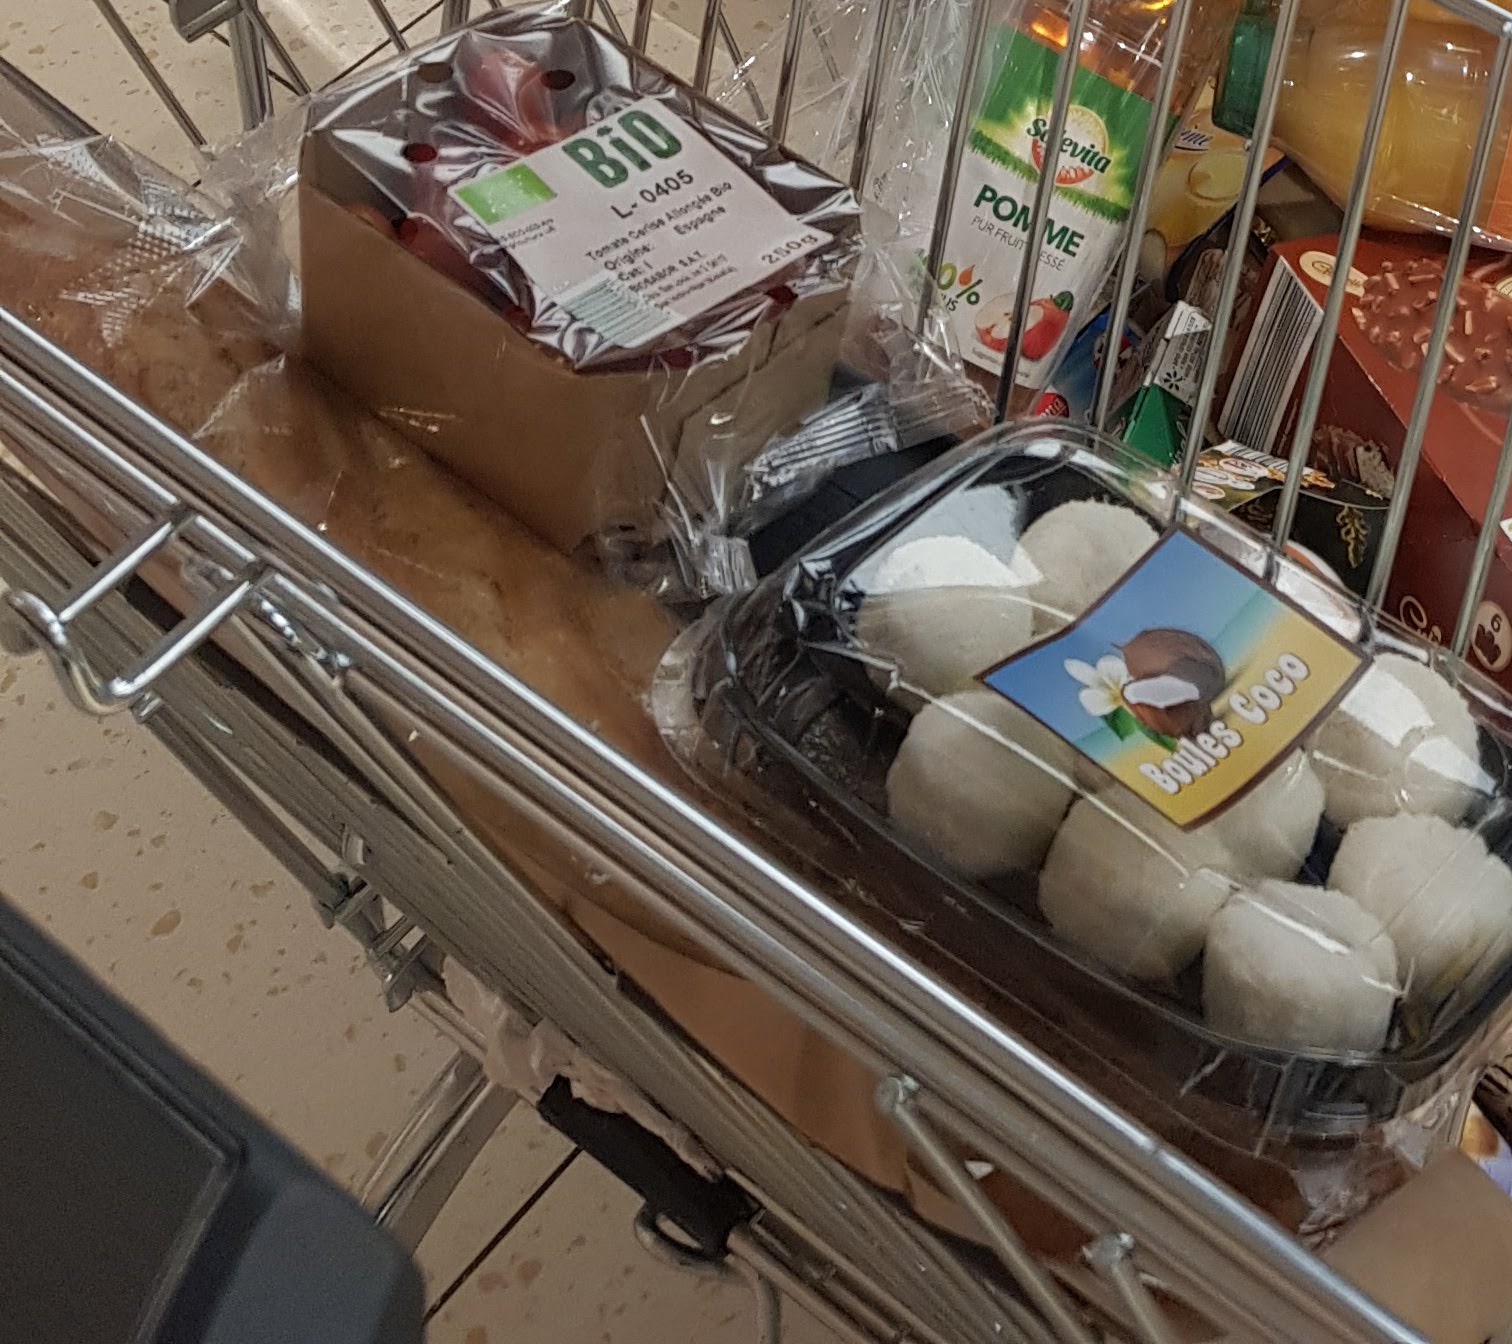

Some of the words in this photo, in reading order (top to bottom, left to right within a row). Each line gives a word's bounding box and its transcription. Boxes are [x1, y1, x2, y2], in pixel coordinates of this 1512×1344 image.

[639, 169, 696, 205] 0405
[584, 233, 630, 263] Tomate
[627, 216, 667, 245] Cerise
[711, 180, 733, 201] Bio
[674, 204, 727, 236] Espagne
[971, 214, 995, 236] PUR
[761, 233, 820, 266] 250g
[1490, 612, 1504, 634] 6
[1138, 718, 1245, 797] Boules
[1228, 650, 1311, 727] Coco
